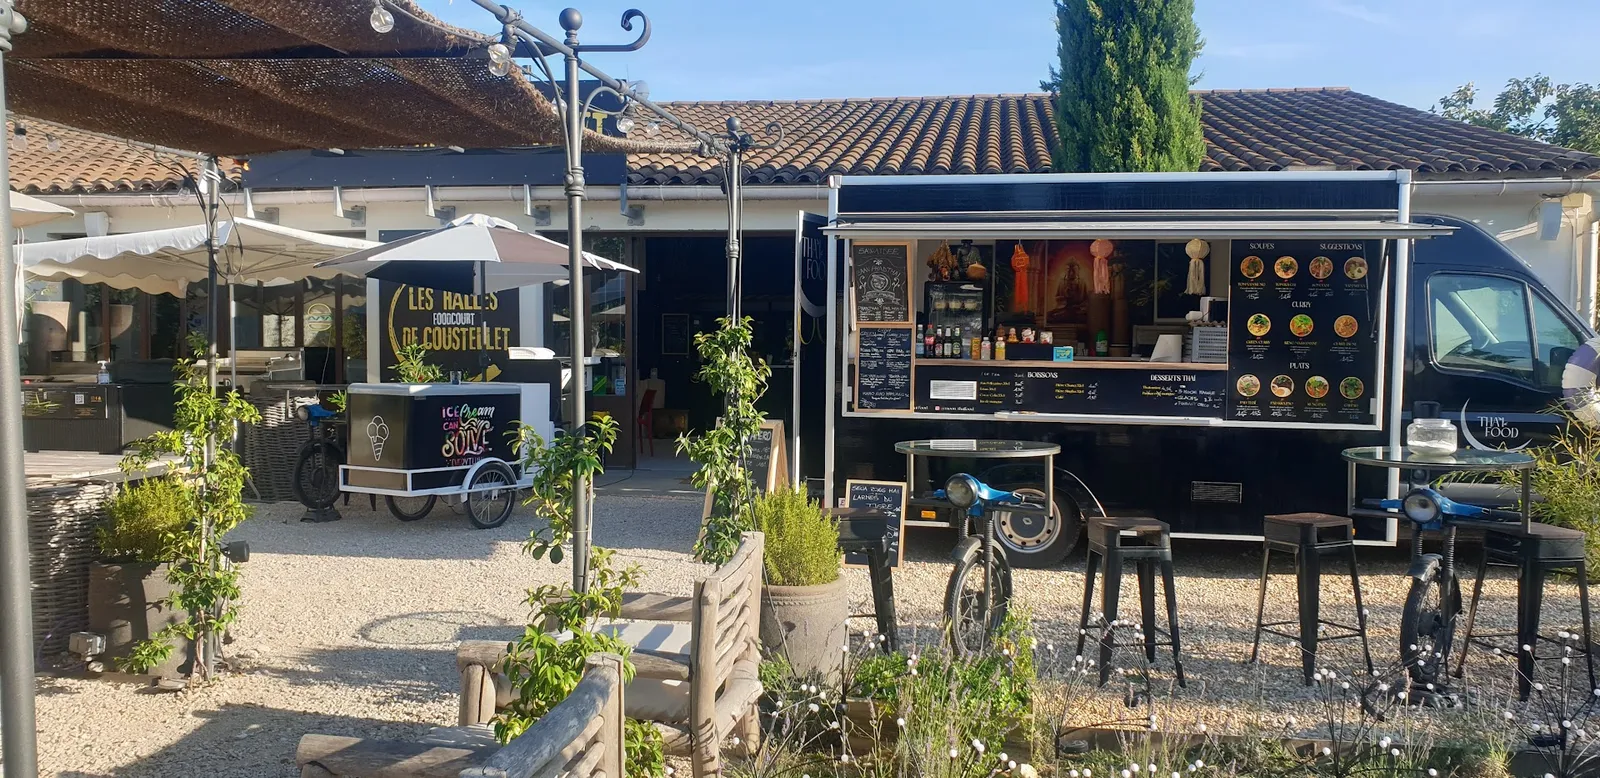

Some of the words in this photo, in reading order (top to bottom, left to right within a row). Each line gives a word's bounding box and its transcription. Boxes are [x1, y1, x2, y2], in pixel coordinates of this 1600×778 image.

[806, 259, 827, 280] FOO
[408, 287, 434, 310] LES
[432, 312, 475, 326] FOODCOURT
[402, 327, 418, 346] DE
[423, 327, 510, 351] COUSTELLET
[442, 406, 460, 418] ICE
[443, 421, 459, 431] CAN
[1485, 426, 1519, 438] FOOD
[442, 418, 494, 457] SOLVE
